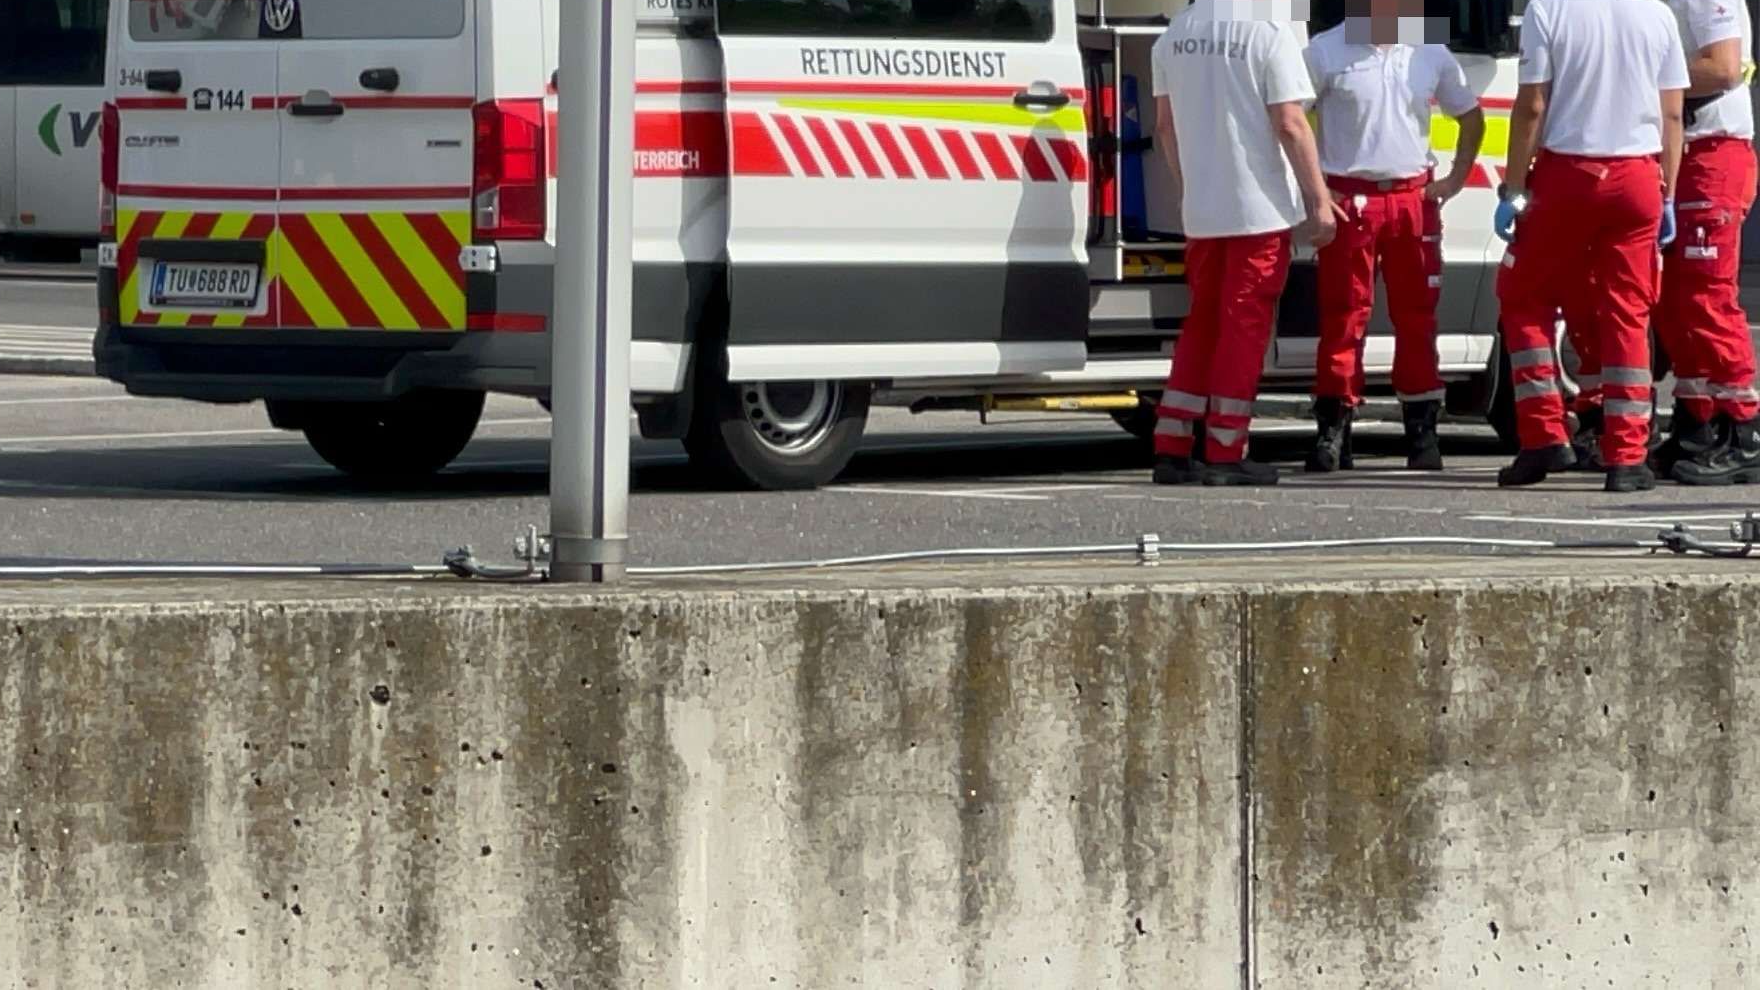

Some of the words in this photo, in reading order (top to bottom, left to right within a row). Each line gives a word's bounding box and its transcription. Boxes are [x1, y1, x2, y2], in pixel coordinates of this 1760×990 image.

[800, 47, 1006, 78] RETTUNGSDIENST
[216, 89, 245, 111] 144
[632, 150, 700, 170] TERREICH
[169, 267, 189, 292] TU
[197, 268, 229, 293] 688
[229, 269, 252, 294] RD
